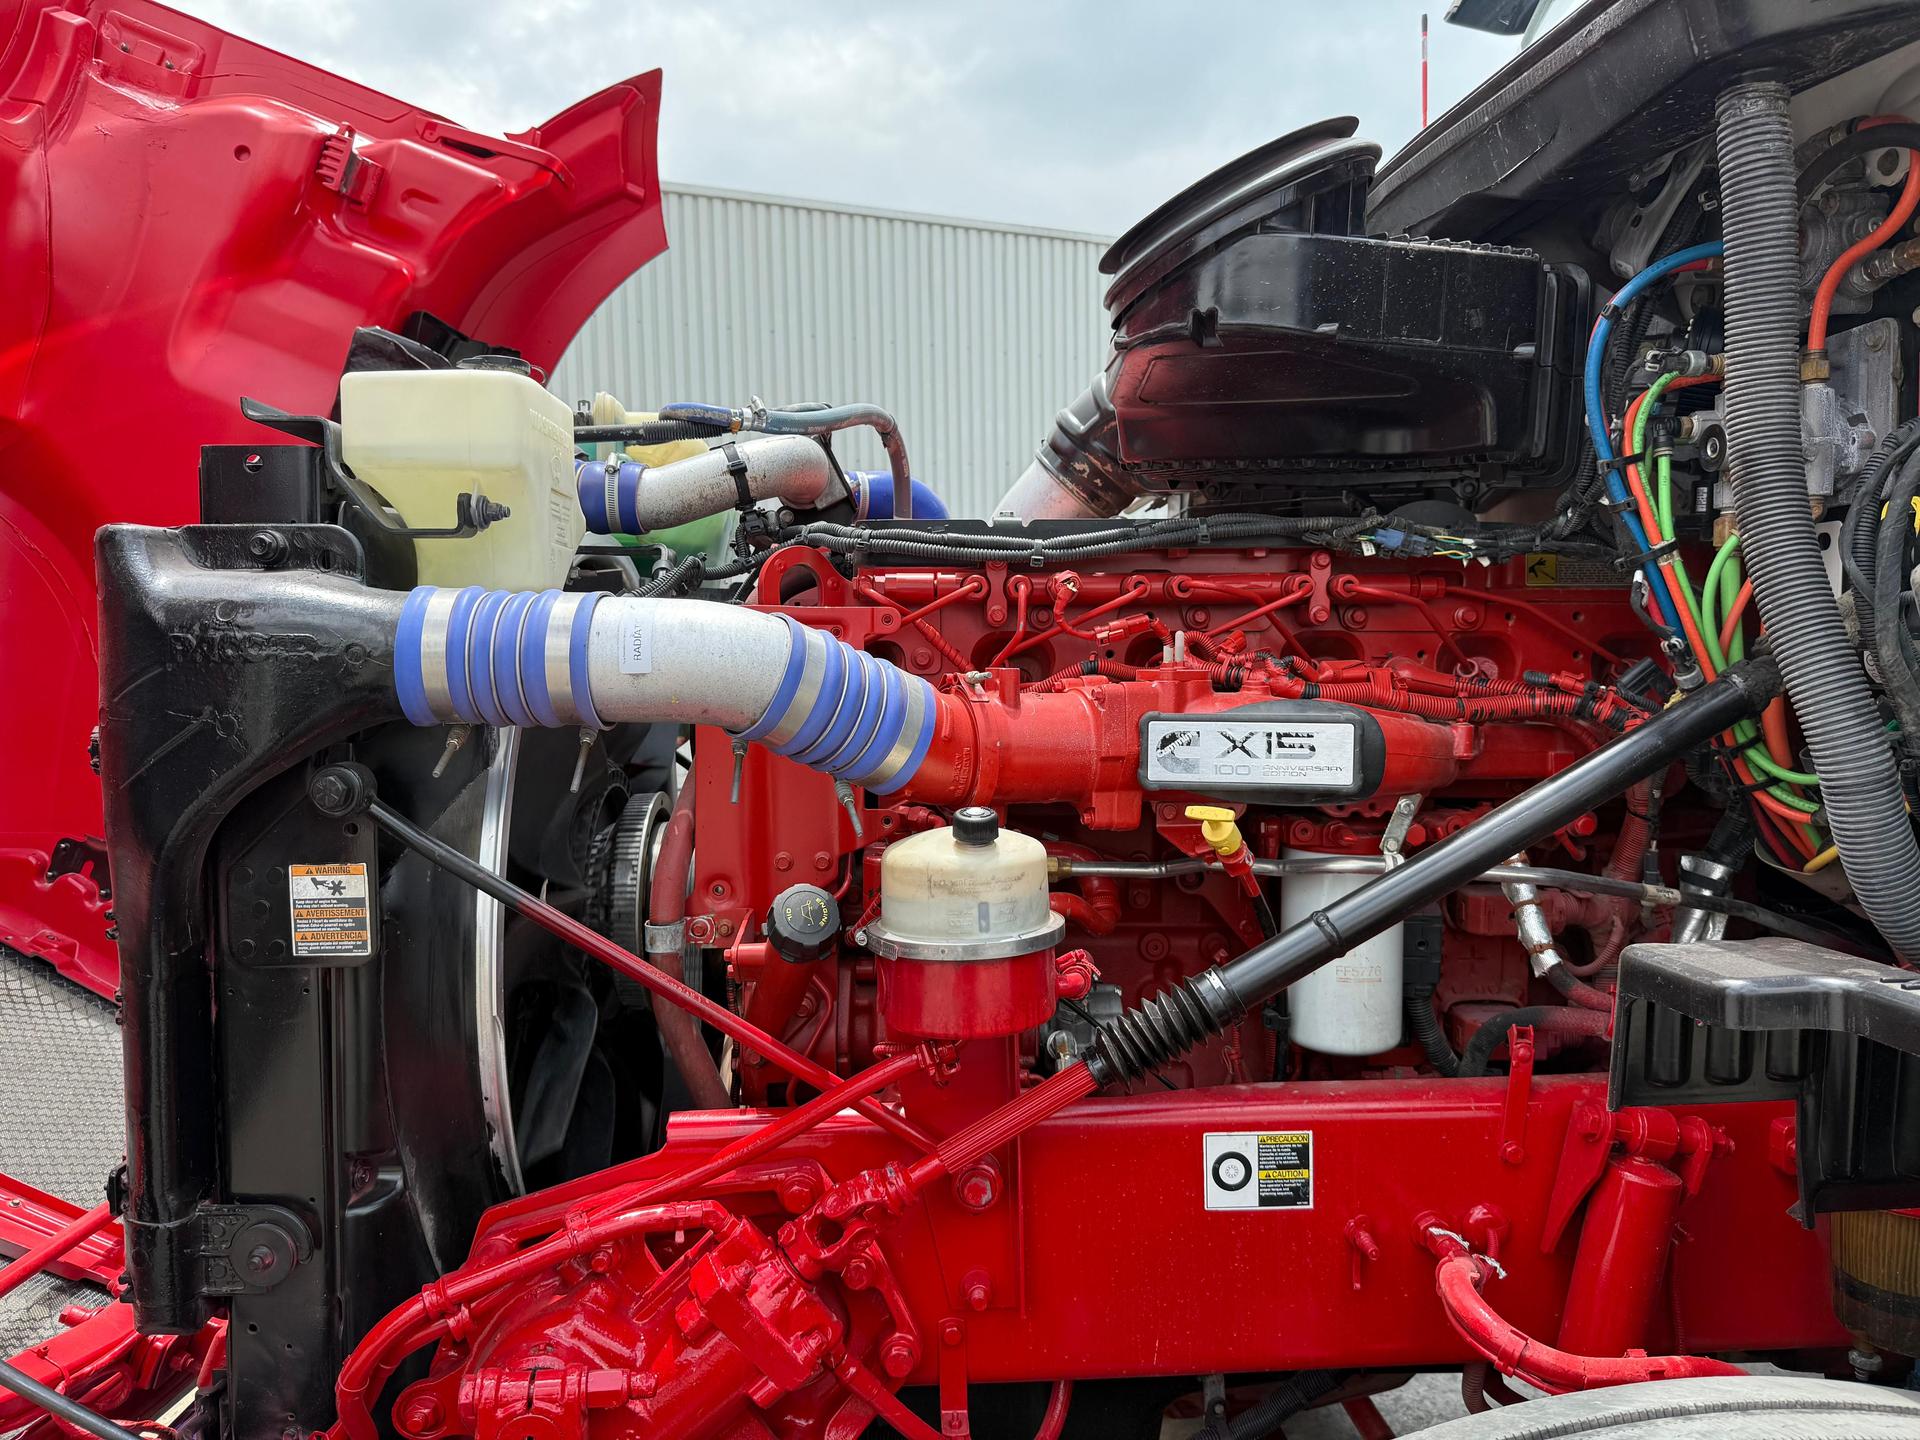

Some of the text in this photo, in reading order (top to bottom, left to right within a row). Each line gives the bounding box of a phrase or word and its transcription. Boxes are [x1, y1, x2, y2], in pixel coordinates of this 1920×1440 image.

[1215, 730, 1317, 760] X15
[315, 866, 351, 874] WARNING
[306, 909, 364, 917] AVERTISSEMENT
[785, 907, 793, 921] OIL
[815, 897, 830, 927] ENGINE
[311, 932, 362, 940] ADVERTENCIA
[1272, 1170, 1304, 1178] CAUTION
